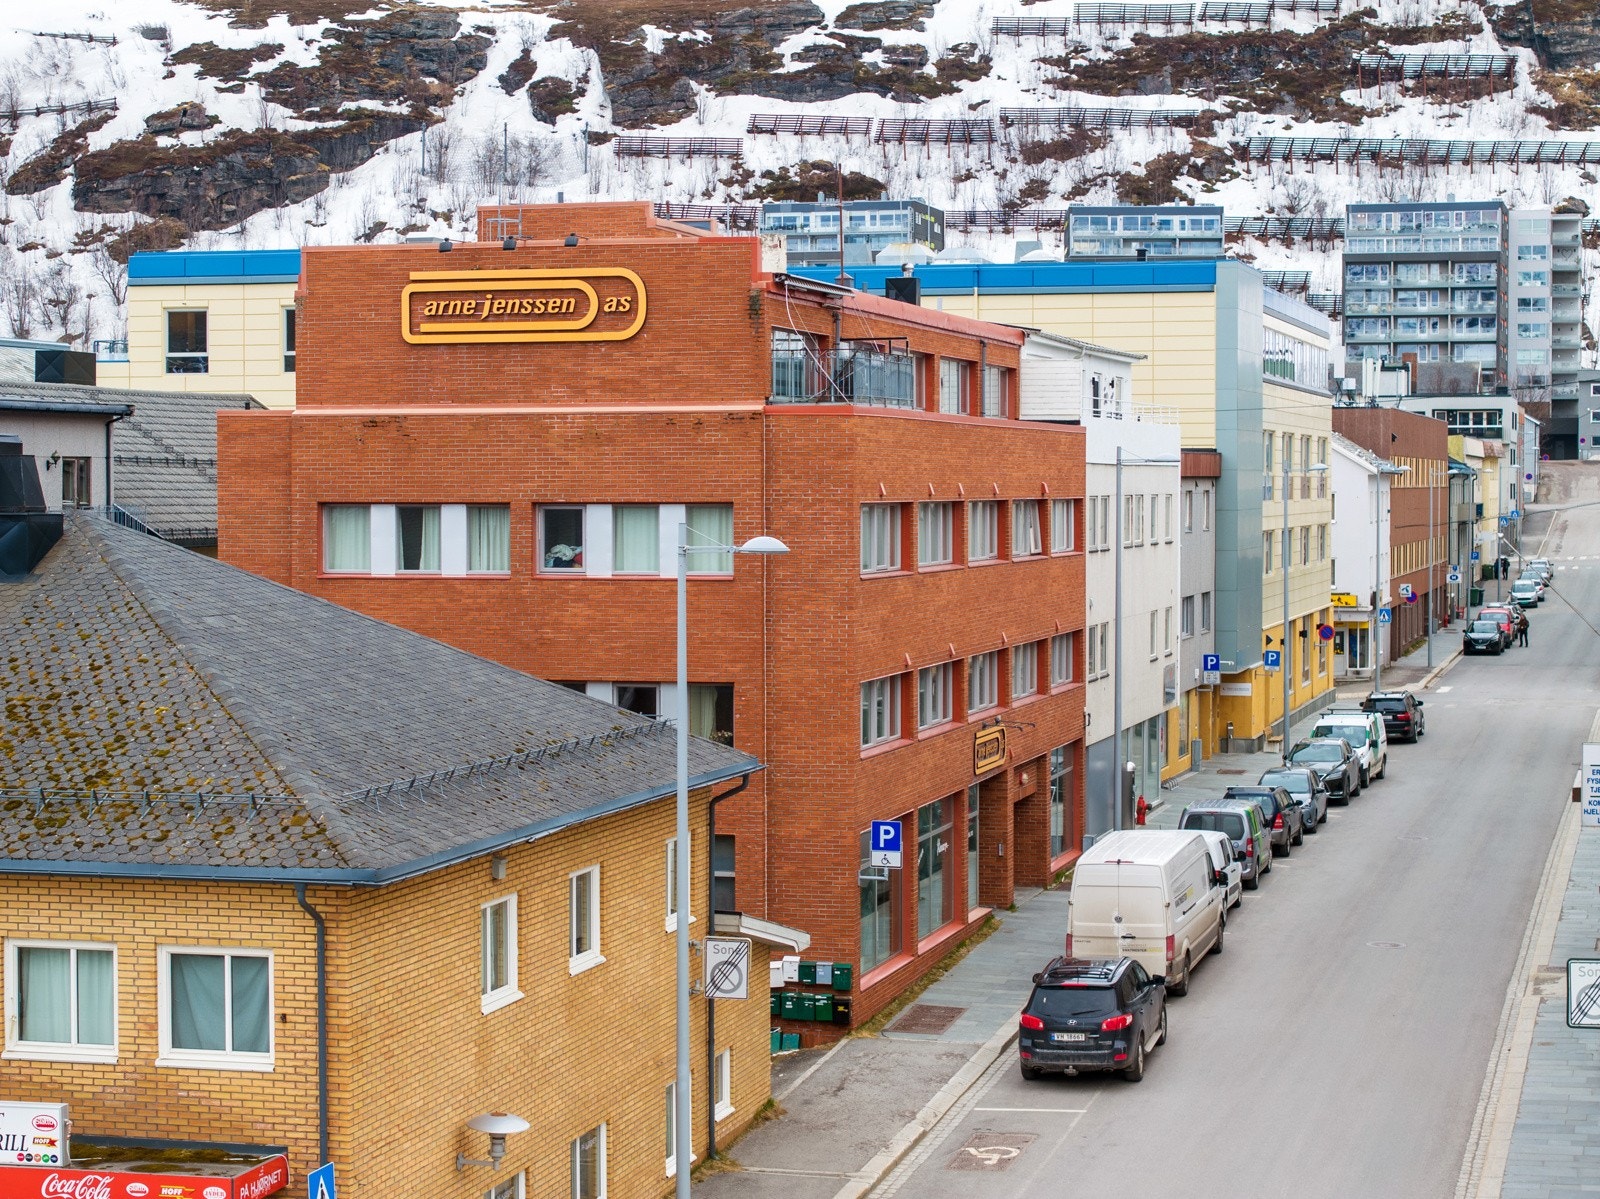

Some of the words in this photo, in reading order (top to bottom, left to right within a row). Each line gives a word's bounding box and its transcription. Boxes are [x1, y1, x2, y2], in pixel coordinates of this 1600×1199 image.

[423, 298, 476, 316] arne
[480, 294, 576, 320] jenssen
[603, 296, 632, 313] as
[1207, 656, 1217, 670] P
[1268, 652, 1277, 664] P
[880, 825, 895, 848] P
[41, 1173, 114, 1199] Coca-Cola
[161, 1187, 183, 1196] HOFF
[250, 1168, 282, 1195] HJØRNET
